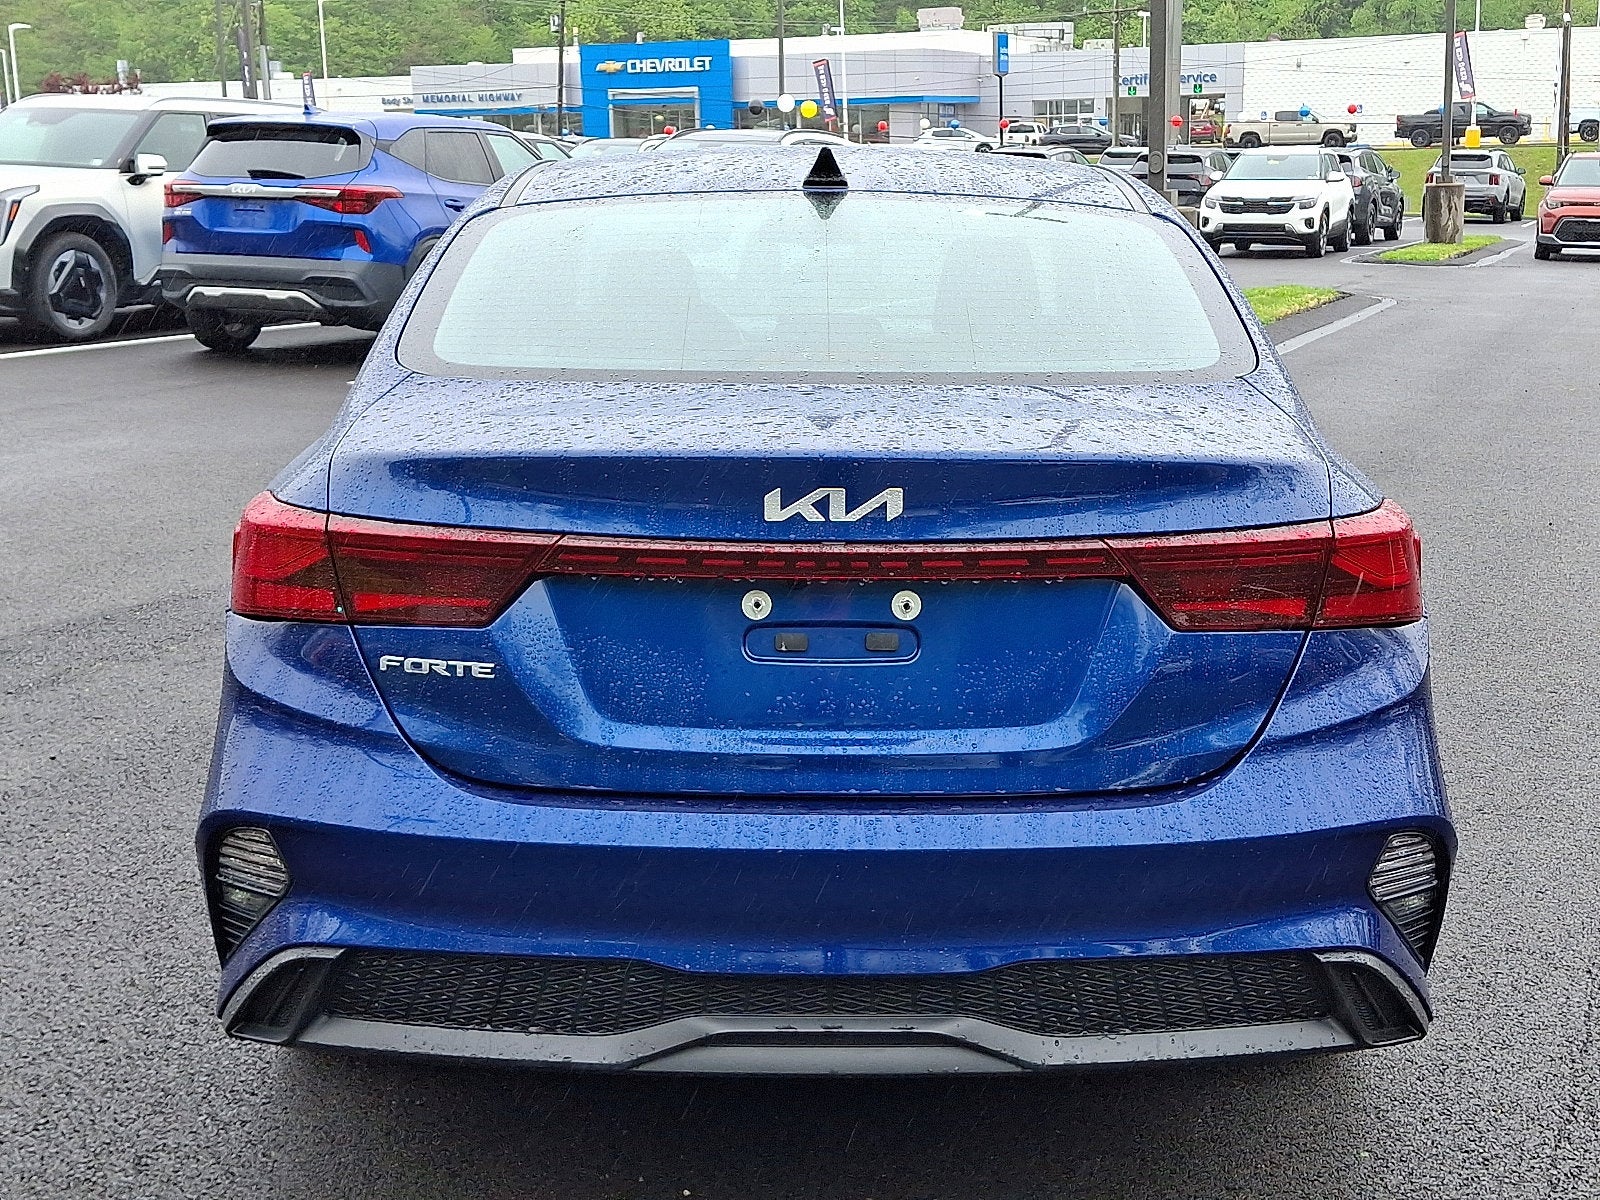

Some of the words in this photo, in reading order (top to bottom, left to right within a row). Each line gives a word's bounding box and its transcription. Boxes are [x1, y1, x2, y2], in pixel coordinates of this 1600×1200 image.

[626, 56, 712, 74] CHEVROLET
[1119, 73, 1149, 86] ertif
[1180, 71, 1217, 84] ervice
[422, 94, 473, 104] MEMORIAL
[478, 92, 522, 102] HIGHWAY
[764, 487, 904, 522] KIA
[379, 654, 496, 679] FORTE
